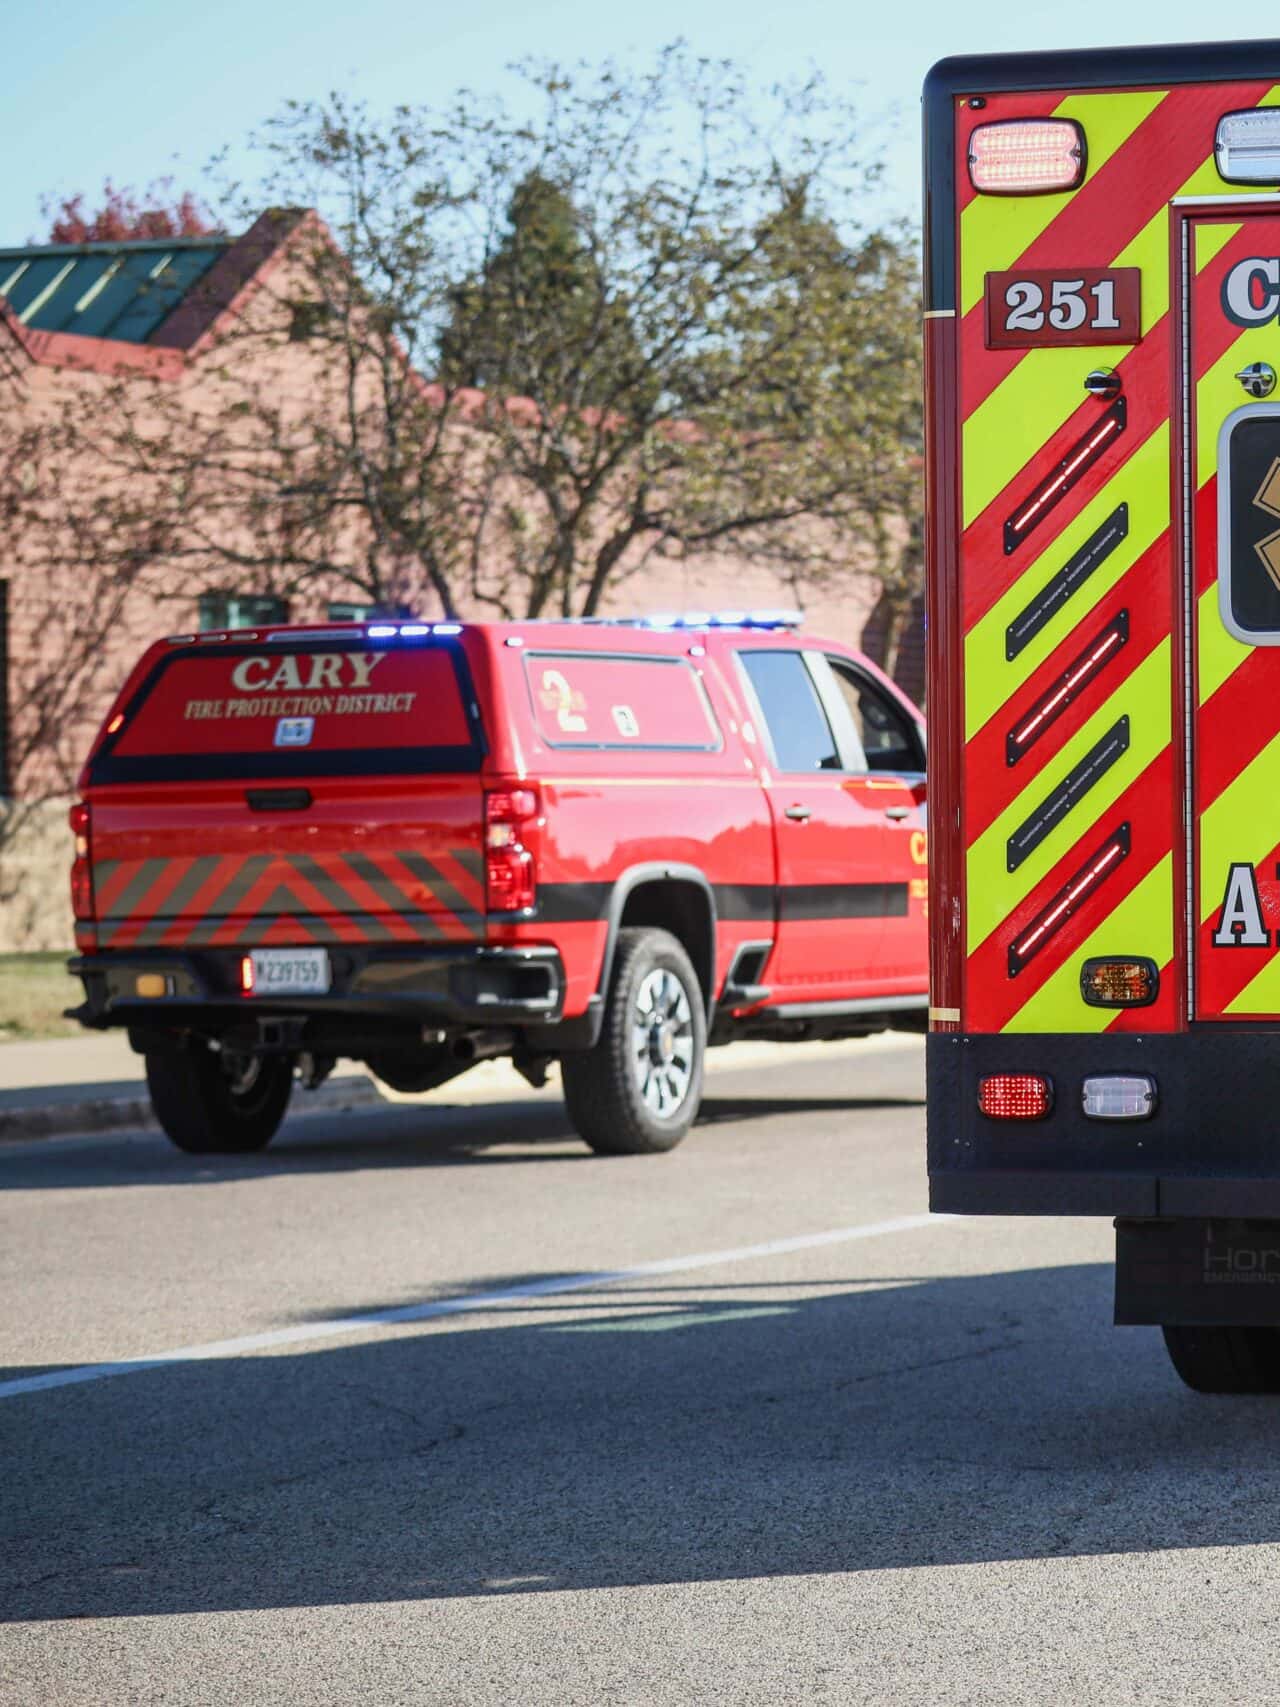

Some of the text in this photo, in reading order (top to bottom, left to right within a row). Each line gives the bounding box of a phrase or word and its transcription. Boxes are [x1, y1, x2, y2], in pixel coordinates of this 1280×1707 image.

[1004, 279, 1121, 331] 251
[232, 652, 387, 691] CARY
[185, 692, 416, 720] FIRE PROTECTION DISTRICT
[543, 670, 588, 732] 2
